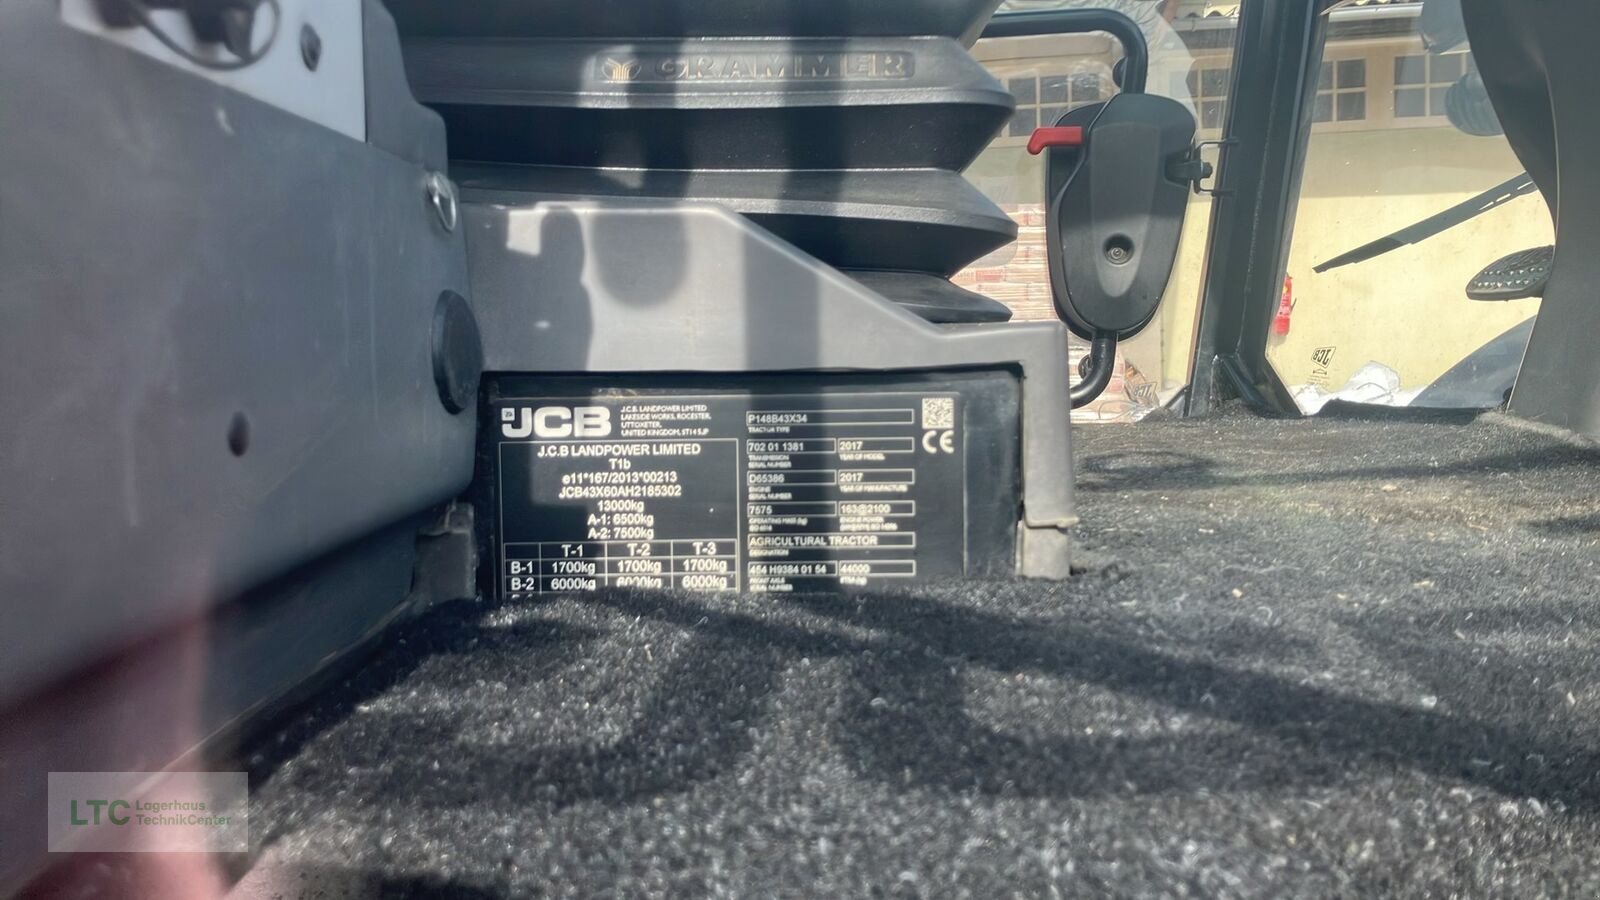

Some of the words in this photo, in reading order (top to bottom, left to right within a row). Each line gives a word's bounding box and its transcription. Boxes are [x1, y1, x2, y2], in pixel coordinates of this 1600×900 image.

[654, 52, 906, 79] GRAMMER
[639, 404, 680, 412] LANDPOWER
[681, 404, 708, 412] LIMITED
[501, 406, 611, 438] JCB
[748, 414, 808, 424] P148B43X34
[620, 428, 646, 437] UNITED
[748, 442, 766, 452] 702
[768, 442, 779, 451] 01
[782, 442, 804, 451] 1381
[840, 441, 864, 450] 2017
[922, 430, 955, 453] CE
[537, 446, 569, 458] J.C.B
[571, 444, 650, 456] LANDPOWER
[652, 444, 701, 456] LIMITED
[608, 458, 632, 470] T1b
[840, 472, 864, 482] 2017
[558, 485, 682, 498] JCB43X60AH2185302
[597, 500, 644, 512] 13000kg
[840, 504, 891, 515] 163@2100
[587, 514, 611, 526] A-1:
[612, 514, 654, 526] 6500kg
[588, 528, 611, 540] A-2:
[614, 527, 654, 540] 7500kg
[750, 536, 827, 546] AGRICULTURAL
[828, 536, 878, 546] TRACTOR
[561, 544, 584, 558] T-1
[627, 543, 650, 556] T-2
[692, 542, 717, 555] T-3
[511, 560, 533, 574] B-1
[552, 561, 596, 576] 1700kg
[618, 560, 662, 576] 1700kg
[683, 558, 728, 574] 1700kg
[800, 564, 812, 574] 01
[840, 564, 870, 574] 44000
[511, 577, 534, 590] B-2
[551, 578, 596, 591] 6000kg
[682, 575, 728, 591] 6000kg
